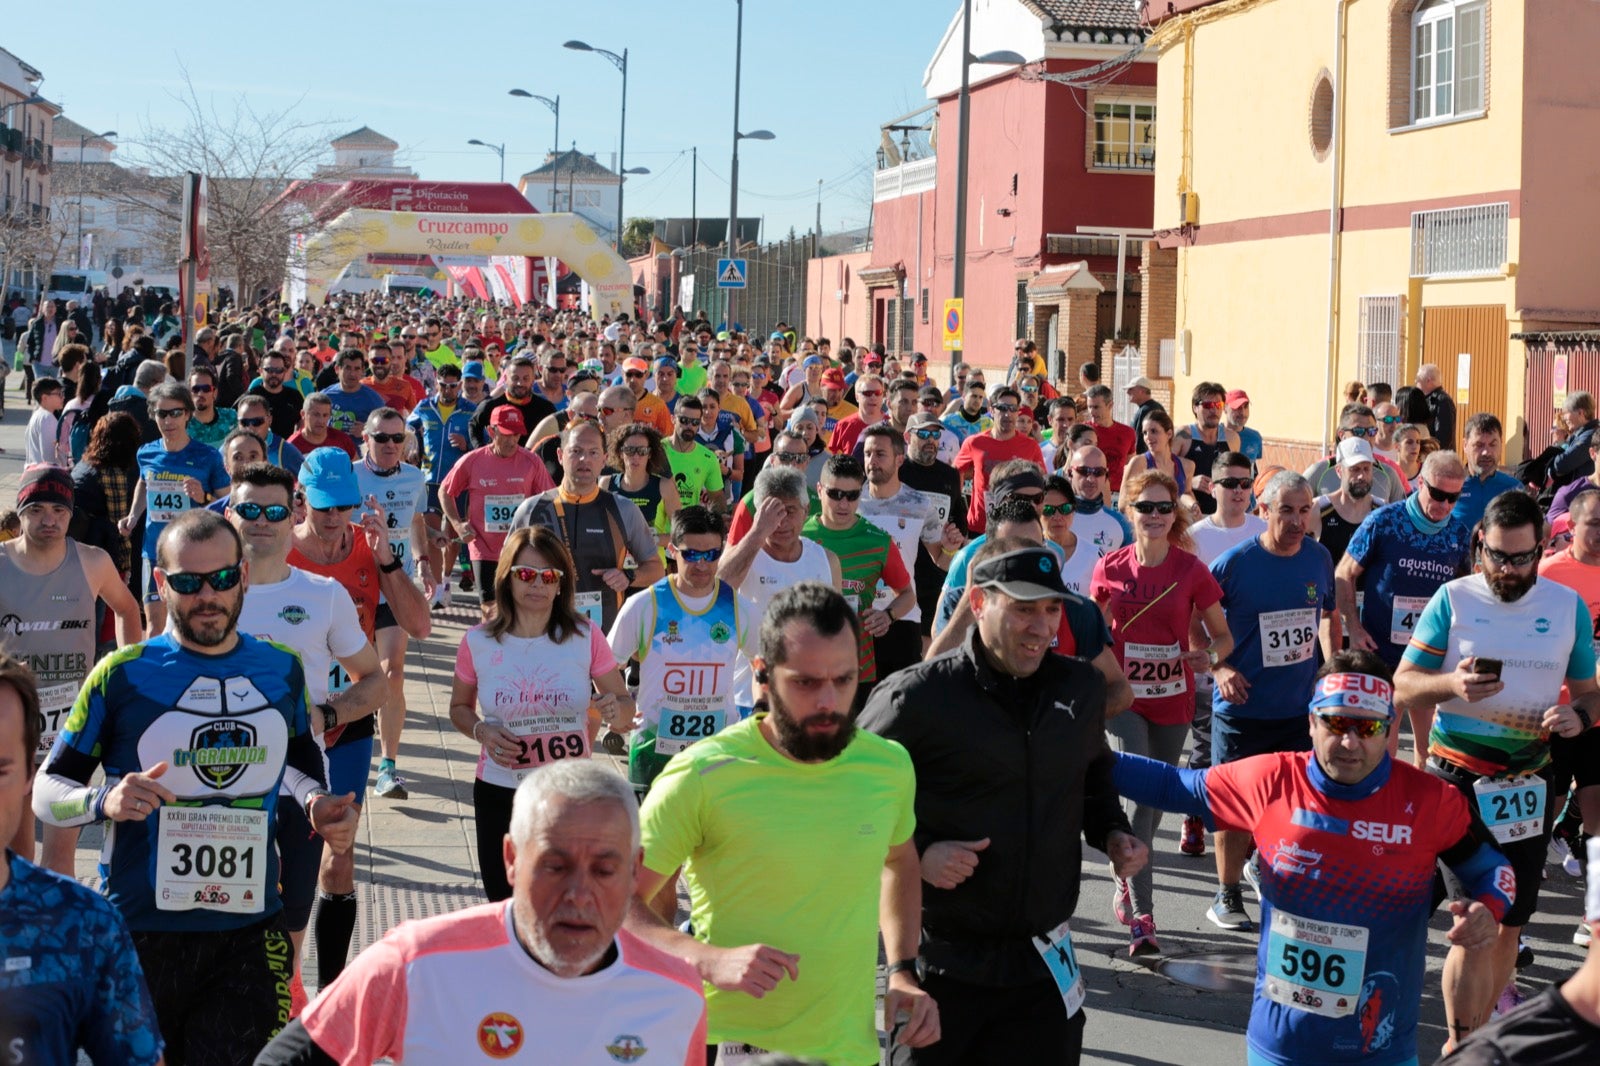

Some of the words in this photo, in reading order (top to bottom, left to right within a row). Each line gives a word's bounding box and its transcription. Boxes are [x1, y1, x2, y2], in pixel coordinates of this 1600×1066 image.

[415, 188, 469, 200] Diputación
[415, 201, 427, 211] de
[428, 202, 469, 212] Granada
[418, 218, 509, 236] Cruzcampo
[426, 238, 471, 251] Radler
[154, 494, 183, 509] 443
[1398, 558, 1454, 576] agustinos
[1407, 571, 1446, 581] GRANADA
[18, 620, 90, 631] WOLFBIKE
[1401, 612, 1420, 630] 4
[1268, 626, 1313, 649] 3136
[329, 664, 352, 688] 1
[1128, 660, 1183, 681] 2204
[1325, 673, 1390, 702] SEUR
[495, 691, 513, 706] Por
[520, 691, 529, 703] ti
[534, 691, 569, 706] mujer
[213, 722, 236, 731] CLUB
[523, 719, 536, 727] GRAN
[669, 715, 715, 737] 828
[174, 745, 268, 766] triGRANADA
[516, 734, 584, 764] 2169
[1492, 790, 1537, 820] 219
[189, 813, 207, 822] GRAN
[209, 813, 234, 824] PREMIO
[234, 815, 242, 824] DE
[243, 815, 261, 825] FONDO
[1352, 820, 1412, 844] SEUR
[171, 843, 254, 879] 3081
[1306, 921, 1329, 935] PREMIO
[1330, 926, 1340, 936] DE
[1281, 943, 1346, 988] 596
